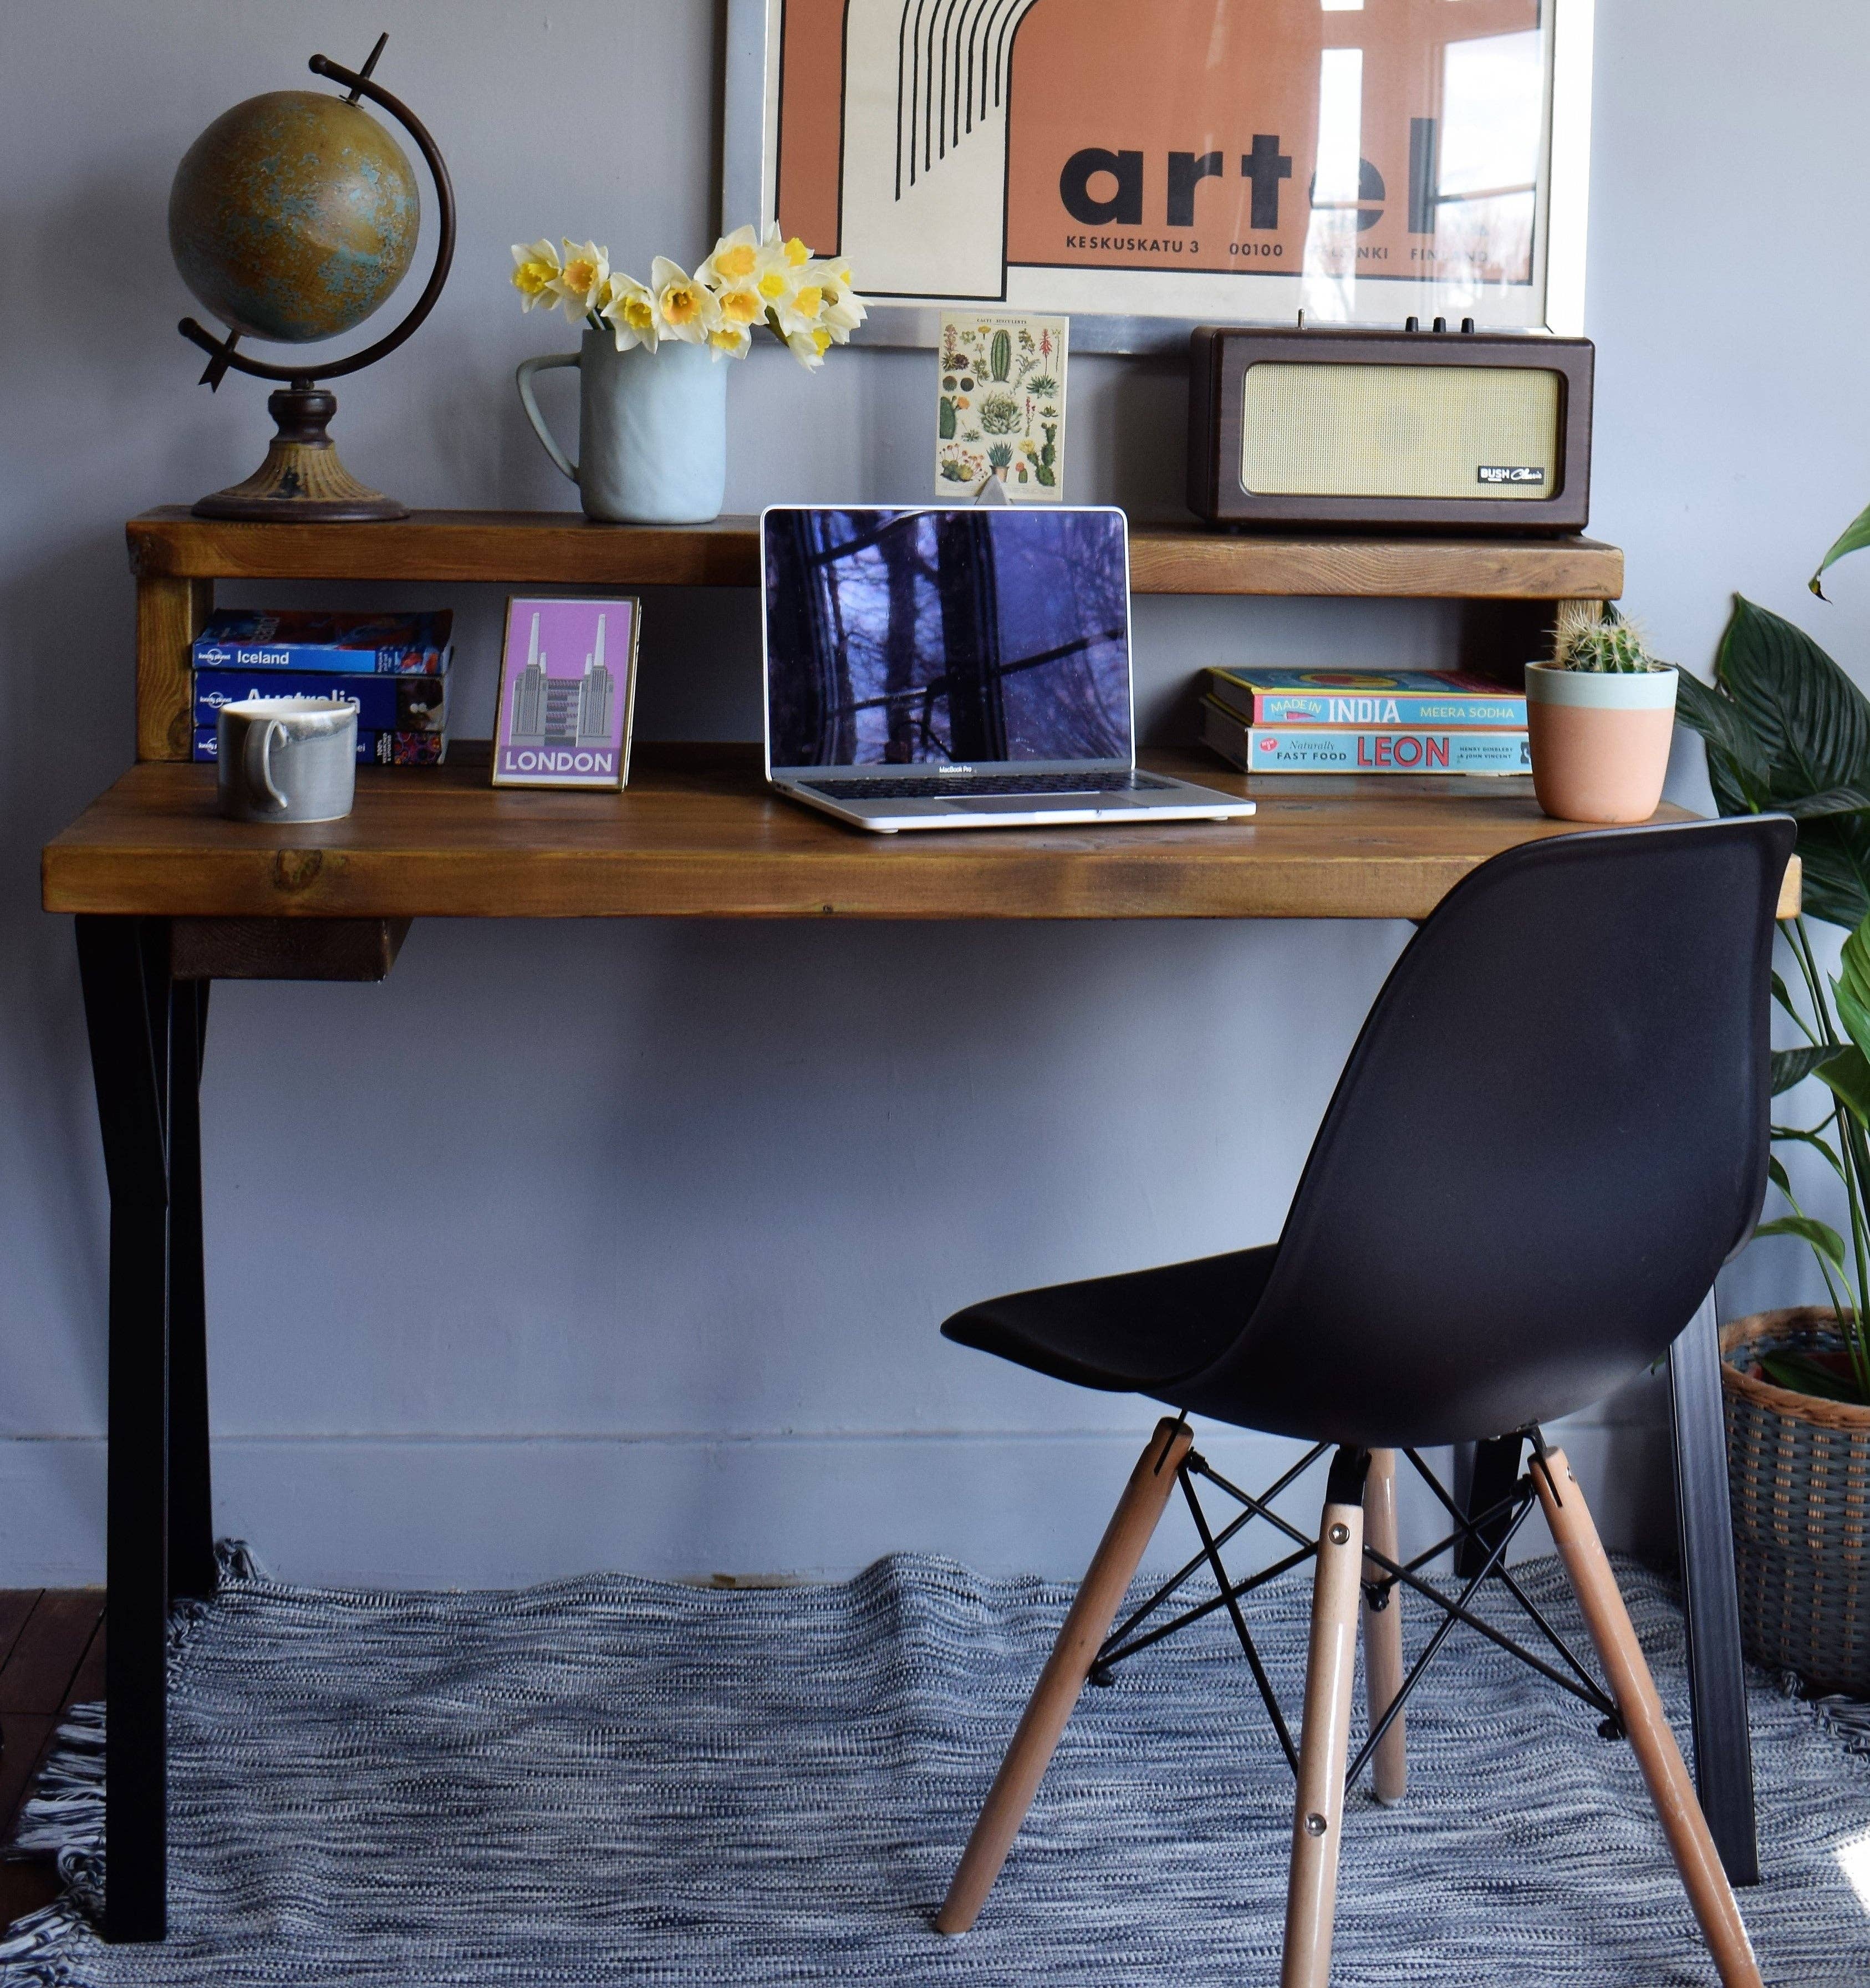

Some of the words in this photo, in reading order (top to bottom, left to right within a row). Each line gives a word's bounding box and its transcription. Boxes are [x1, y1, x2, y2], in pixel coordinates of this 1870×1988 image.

[1066, 236, 1183, 252] KESKUSKATU
[1190, 241, 1199, 253] 3
[1230, 243, 1283, 256] 00100
[1481, 468, 1510, 479] BUSH
[237, 650, 289, 665] Iceland
[1271, 699, 1307, 712] MADE
[1308, 700, 1321, 713] IN
[1328, 699, 1401, 723] INDIA
[1420, 707, 1466, 717] MEERA
[1469, 707, 1514, 718] SODHA
[1290, 741, 1335, 750] Naturally
[1357, 736, 1449, 767] LEON
[506, 751, 612, 771] LONDON
[1313, 752, 1347, 761] FOOD
